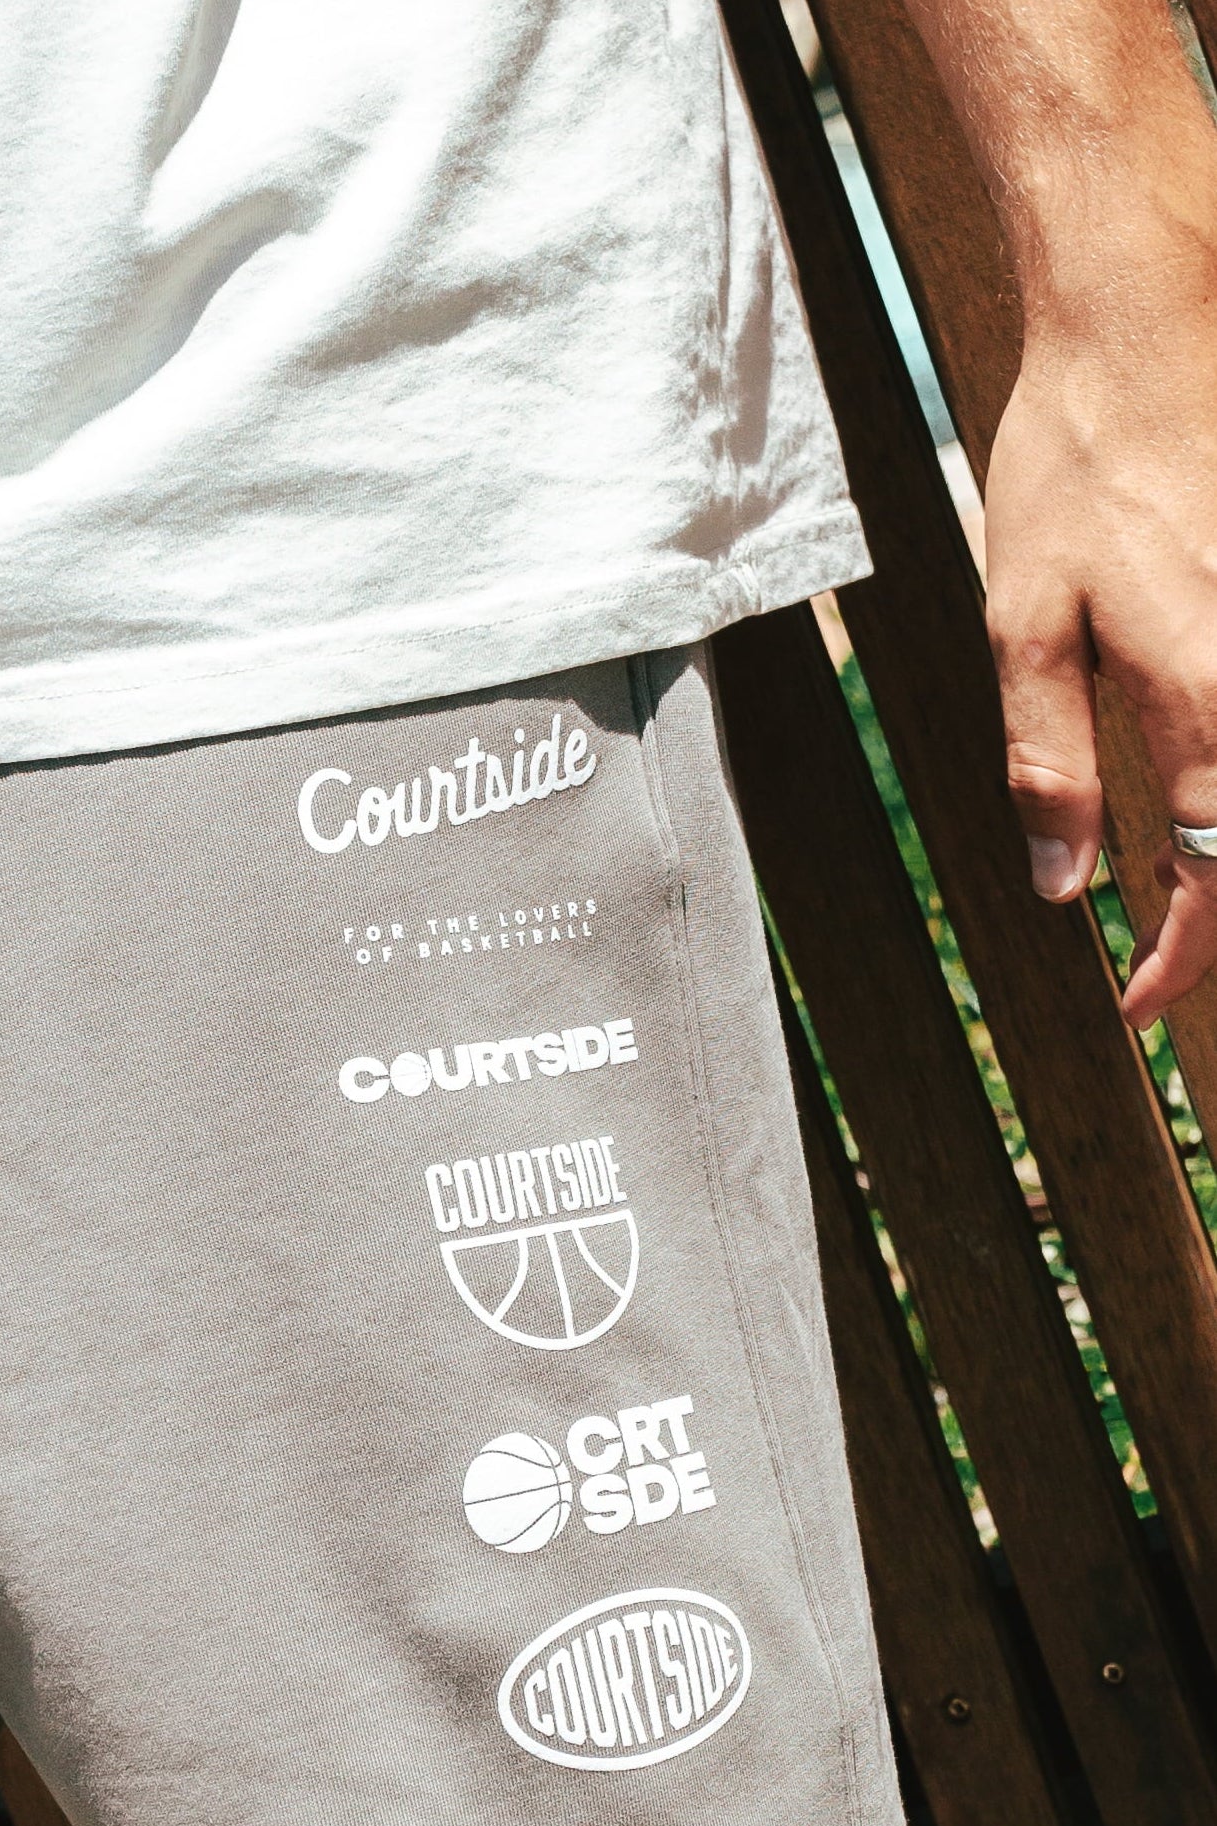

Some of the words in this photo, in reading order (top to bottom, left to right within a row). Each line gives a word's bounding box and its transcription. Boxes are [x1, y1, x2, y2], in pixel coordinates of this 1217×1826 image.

[297, 713, 596, 854] Courtside
[344, 923, 404, 944] FOR
[427, 915, 479, 936] THE
[498, 899, 597, 928] LOVERS
[356, 946, 392, 965] OF
[419, 921, 592, 959] BASKETBALL
[338, 1017, 639, 1103] COURTSIDE
[424, 1135, 627, 1233] COURTSIDE
[566, 1395, 694, 1475] CRT
[580, 1451, 716, 1535] SDE
[523, 1609, 739, 1748] COURTSIDE
